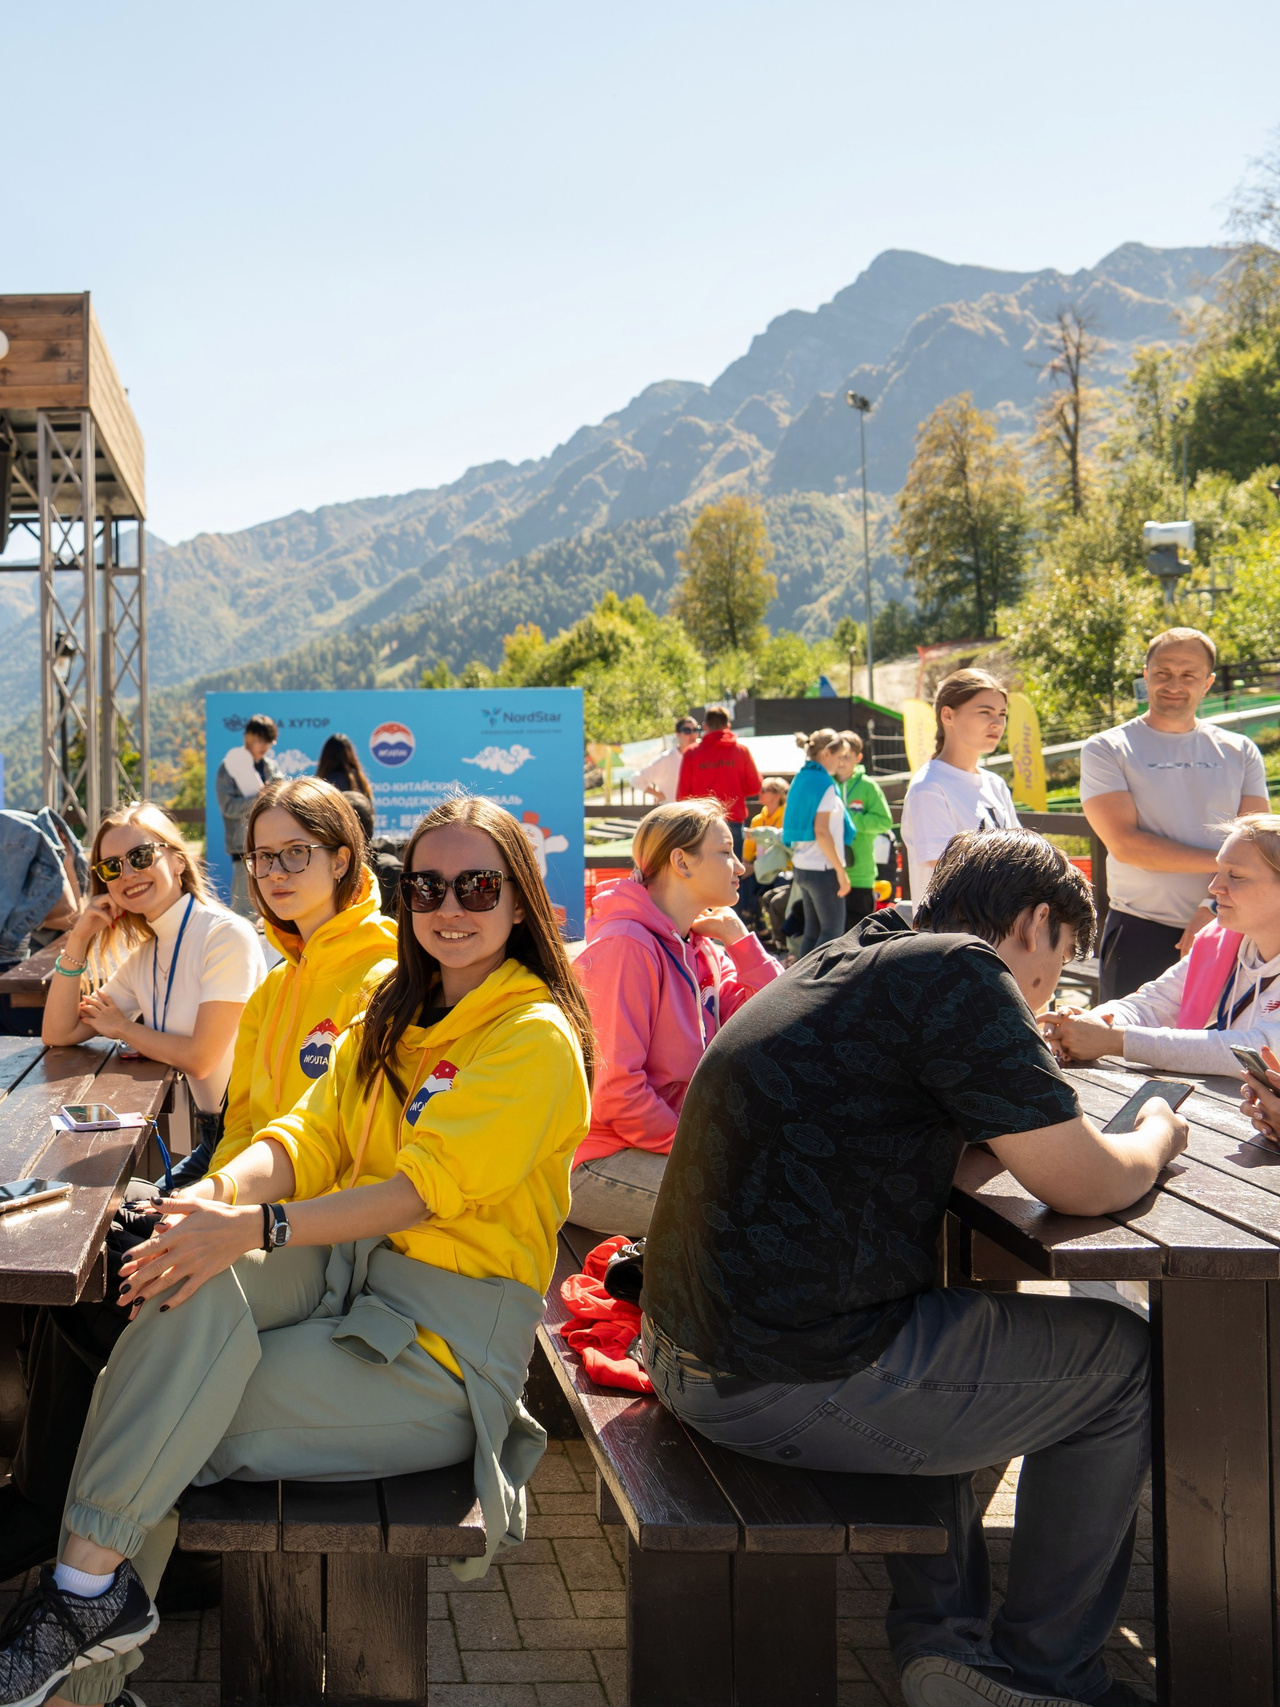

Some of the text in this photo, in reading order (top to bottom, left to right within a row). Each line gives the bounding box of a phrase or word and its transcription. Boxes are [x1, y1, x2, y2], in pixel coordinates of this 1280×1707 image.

[503, 710, 562, 724] NordStar
[288, 718, 331, 729] ХУТОР
[303, 1054, 330, 1065] MOUTA
